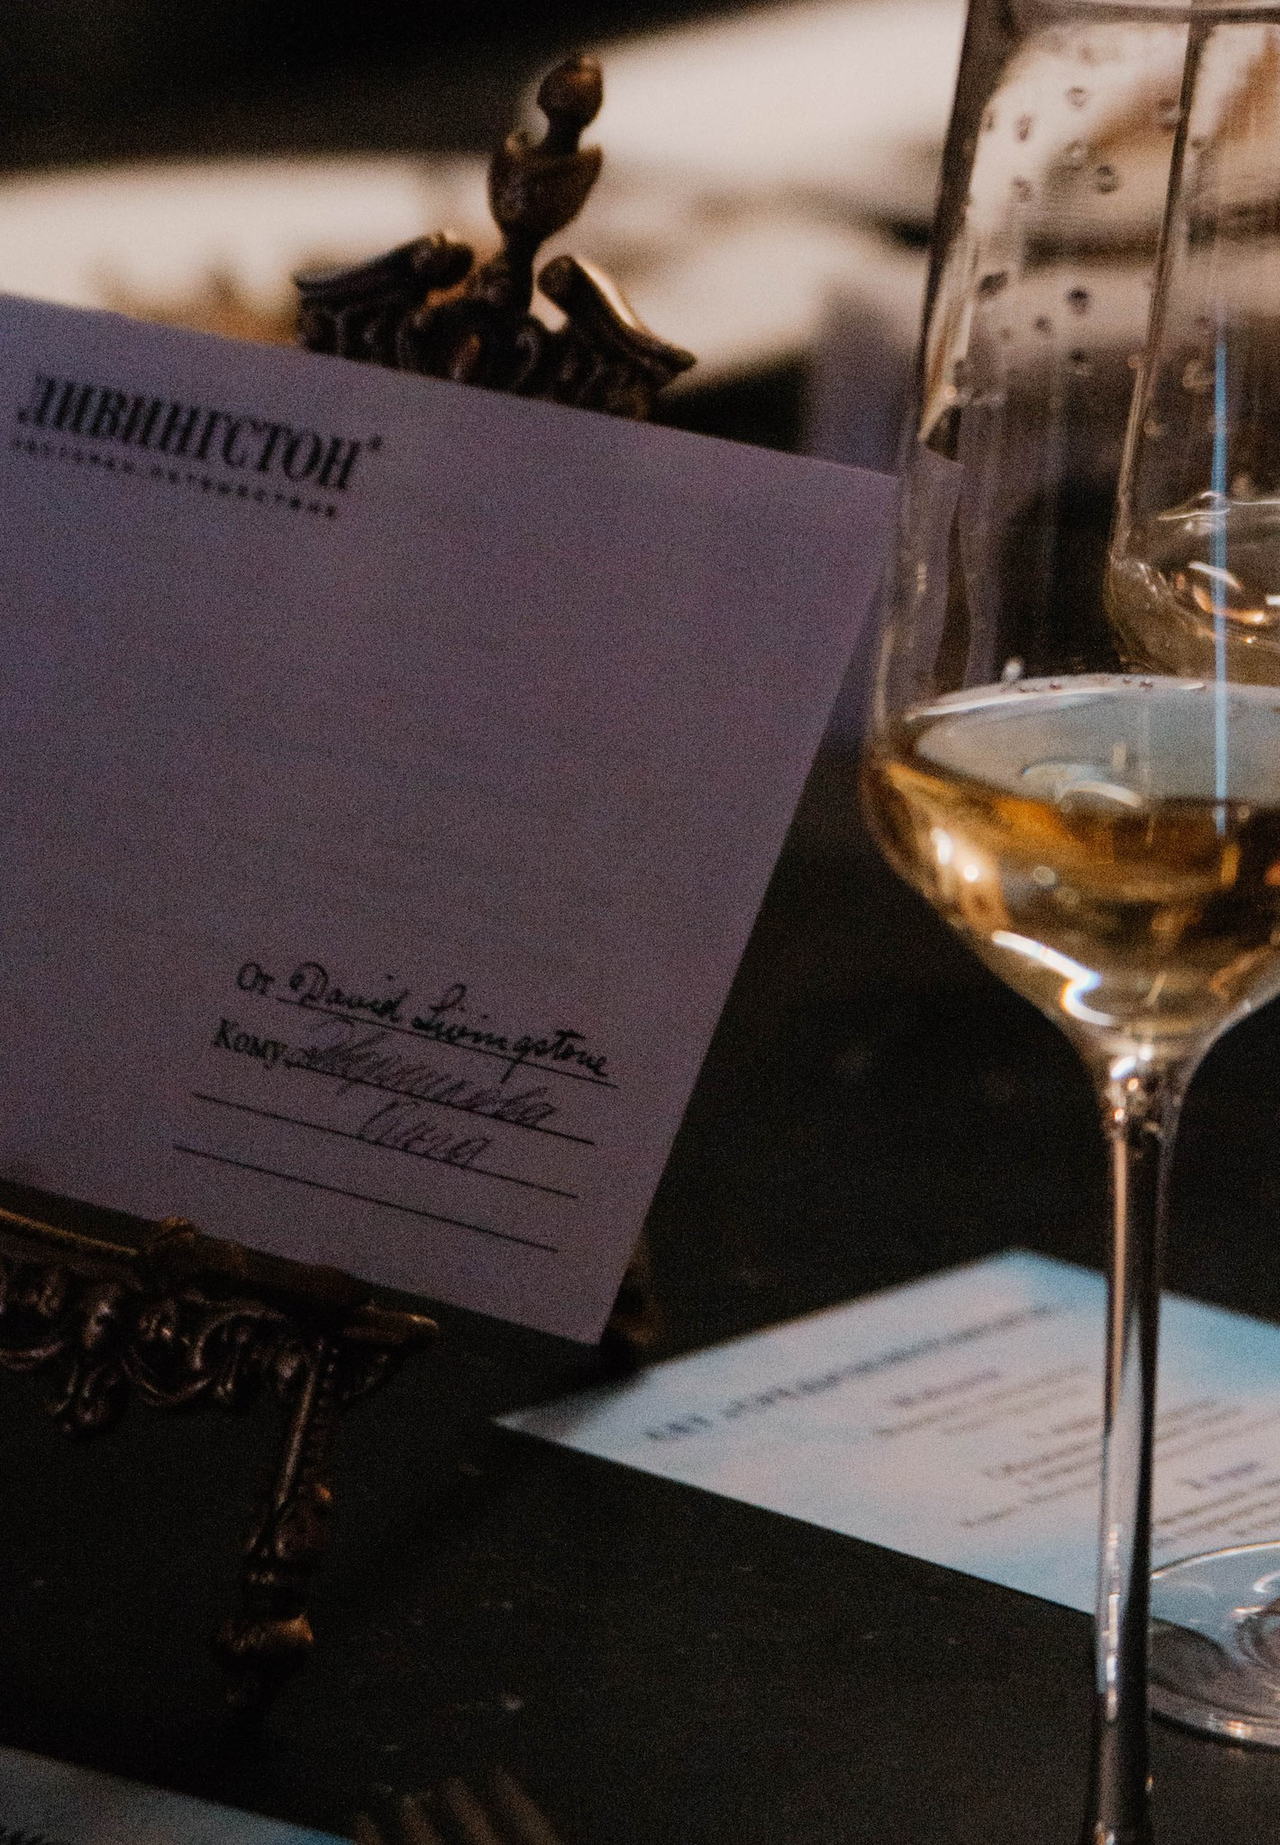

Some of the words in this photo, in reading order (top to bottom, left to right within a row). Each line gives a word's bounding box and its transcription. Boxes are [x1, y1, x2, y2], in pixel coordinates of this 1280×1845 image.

[236, 961, 275, 997] От
[212, 1018, 289, 1070] Кому
[289, 962, 410, 1024] David
[411, 983, 610, 1085] Livingstone
